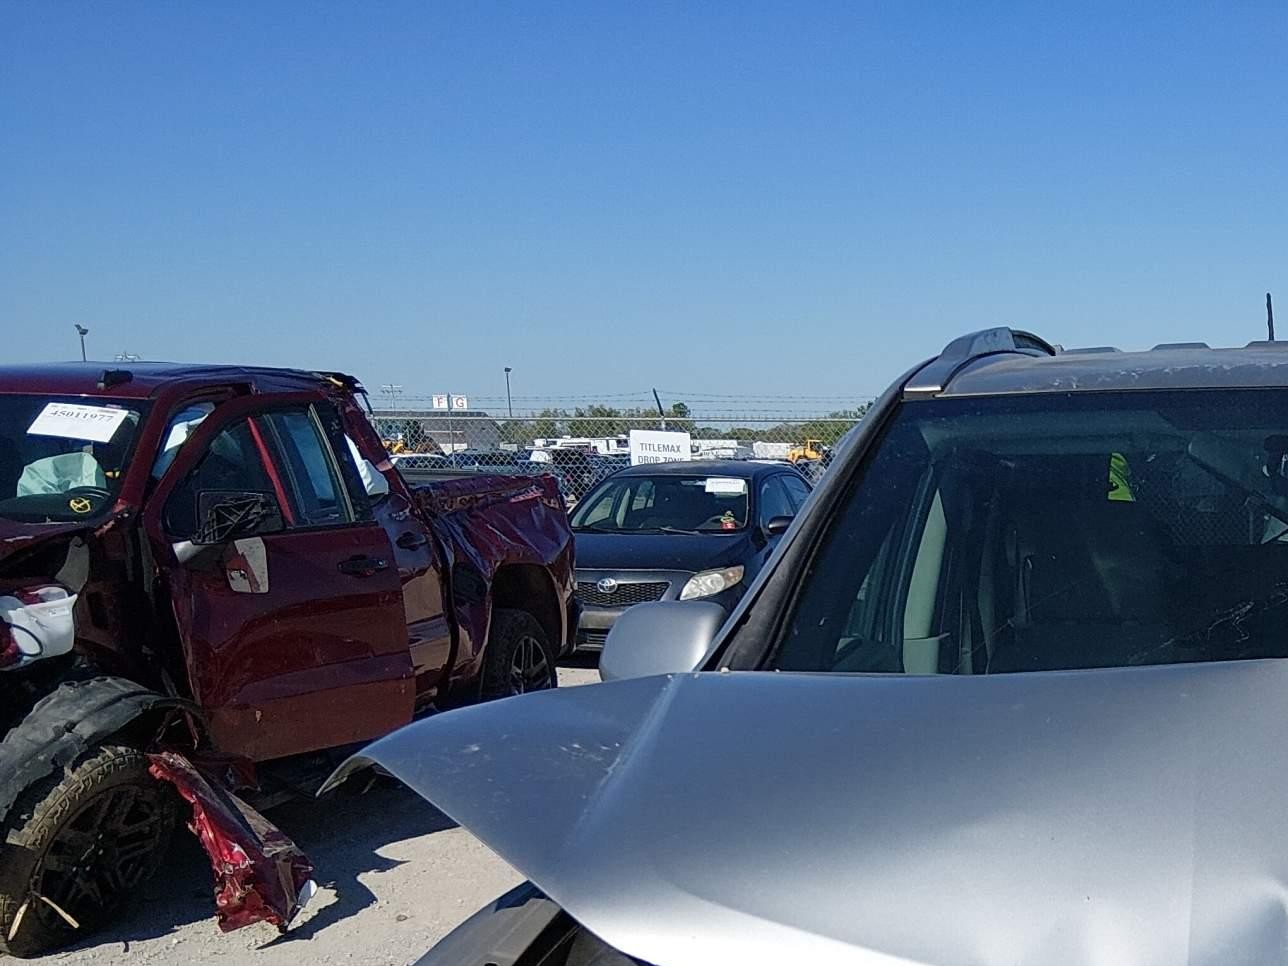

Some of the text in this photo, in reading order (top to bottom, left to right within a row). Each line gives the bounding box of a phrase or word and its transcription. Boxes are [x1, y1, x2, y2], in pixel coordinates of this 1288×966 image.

[437, 397, 444, 407] F
[456, 397, 464, 408] G
[639, 442, 681, 454] TITLEMAX
[637, 455, 661, 465] DROP
